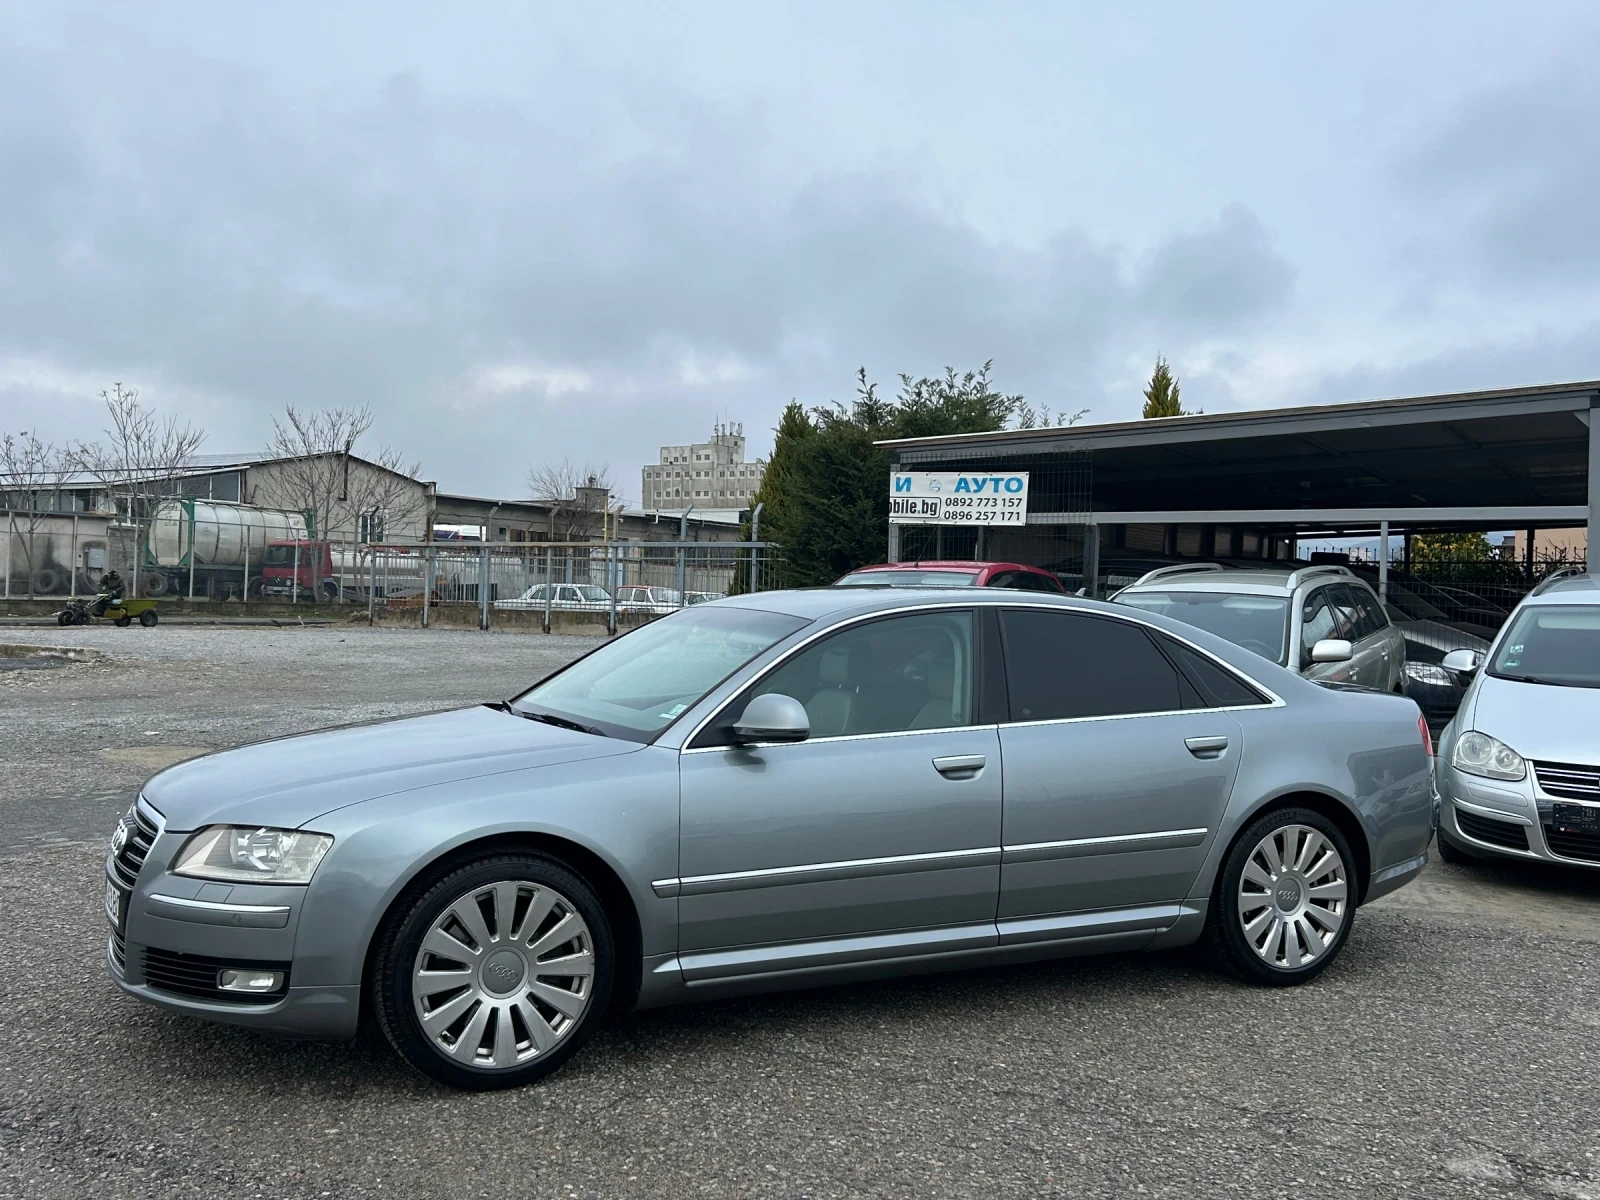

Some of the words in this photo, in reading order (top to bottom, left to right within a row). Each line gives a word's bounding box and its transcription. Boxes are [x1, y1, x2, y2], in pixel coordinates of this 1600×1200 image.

[895, 476, 912, 492] И
[954, 477, 1024, 493] АУТО
[945, 497, 973, 507] 0892
[977, 497, 998, 508] 773
[1001, 498, 1023, 508] 157
[944, 510, 973, 521] 0896
[975, 511, 997, 521] 257
[1000, 511, 1020, 521] 171
